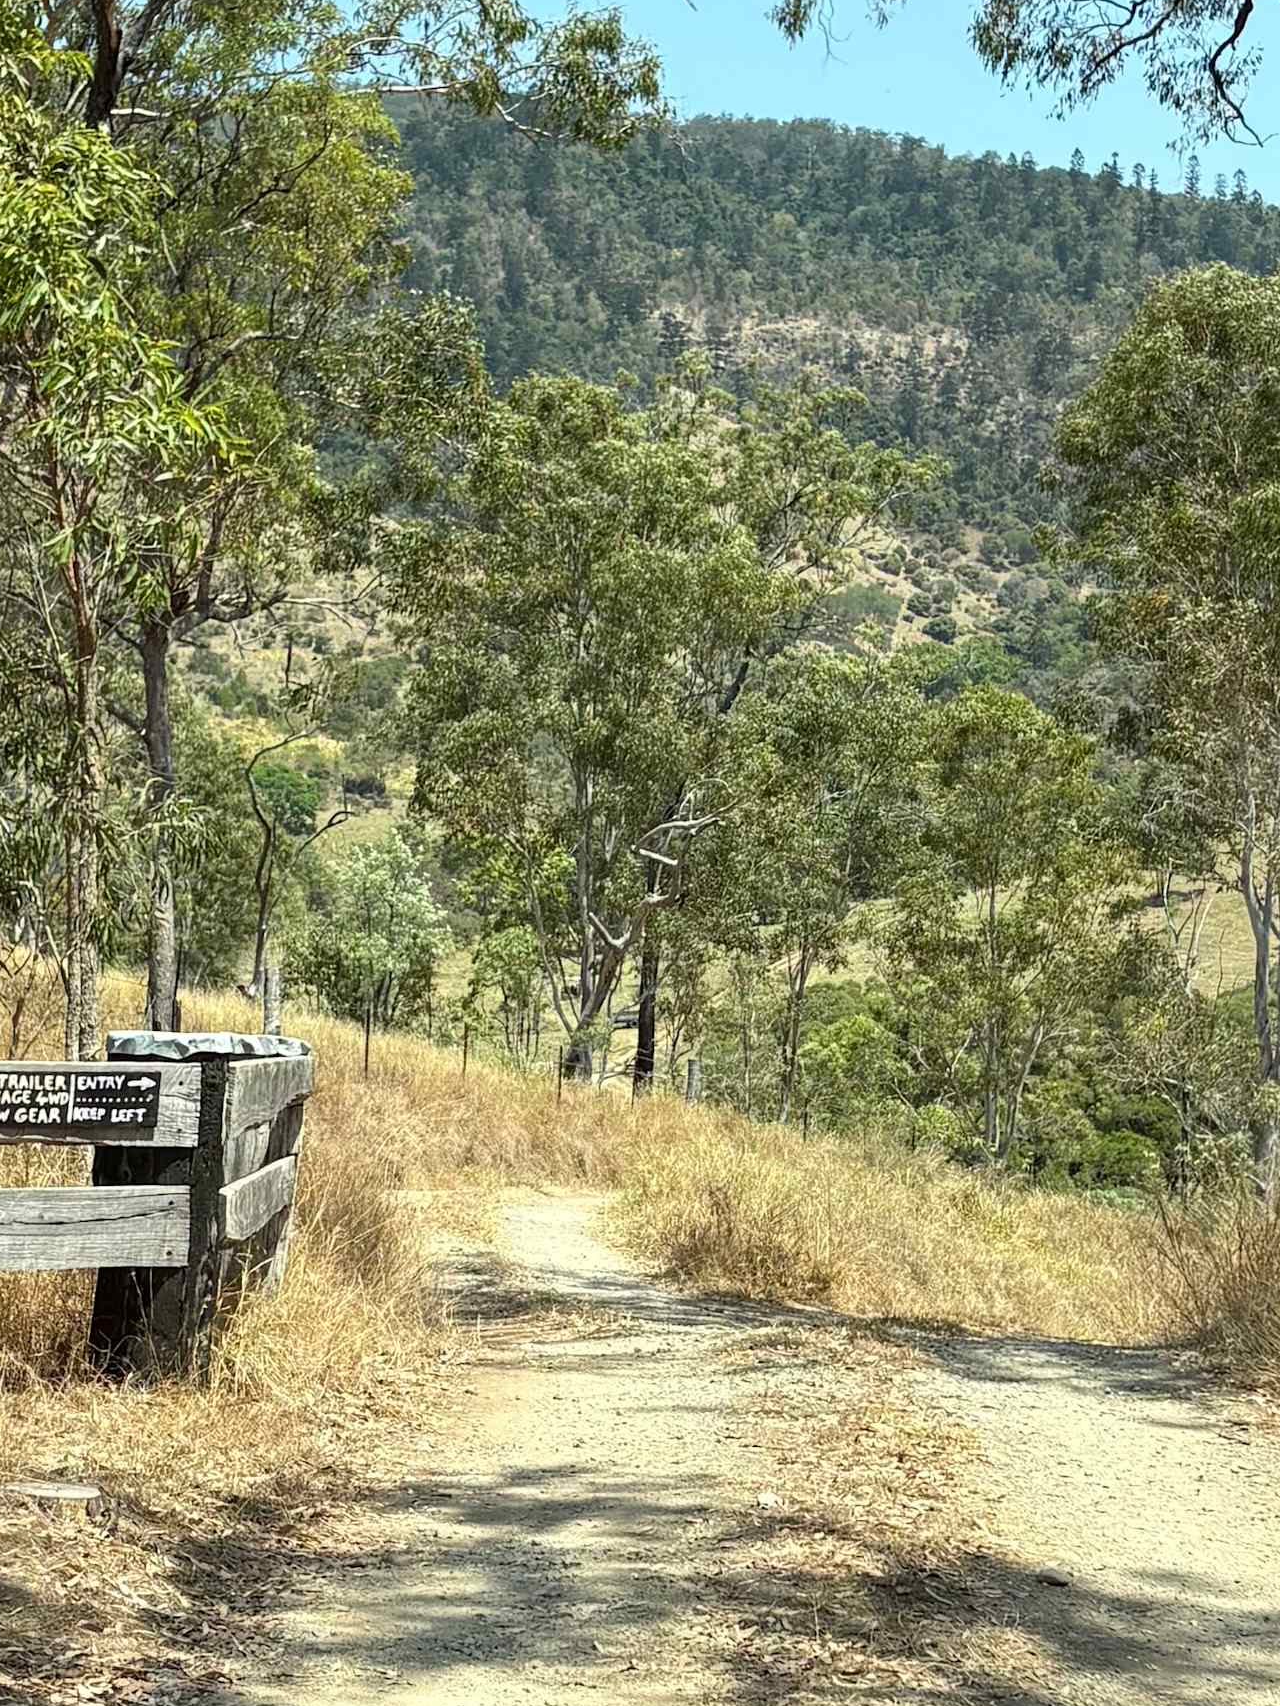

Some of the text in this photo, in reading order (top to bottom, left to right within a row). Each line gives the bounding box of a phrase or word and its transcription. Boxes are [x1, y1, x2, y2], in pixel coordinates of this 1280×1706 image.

[77, 1075, 125, 1090] ENTRY
[35, 1091, 69, 1106] 4WD
[14, 1107, 61, 1124] GEAR
[73, 1106, 147, 1123] KEEP LEFT
